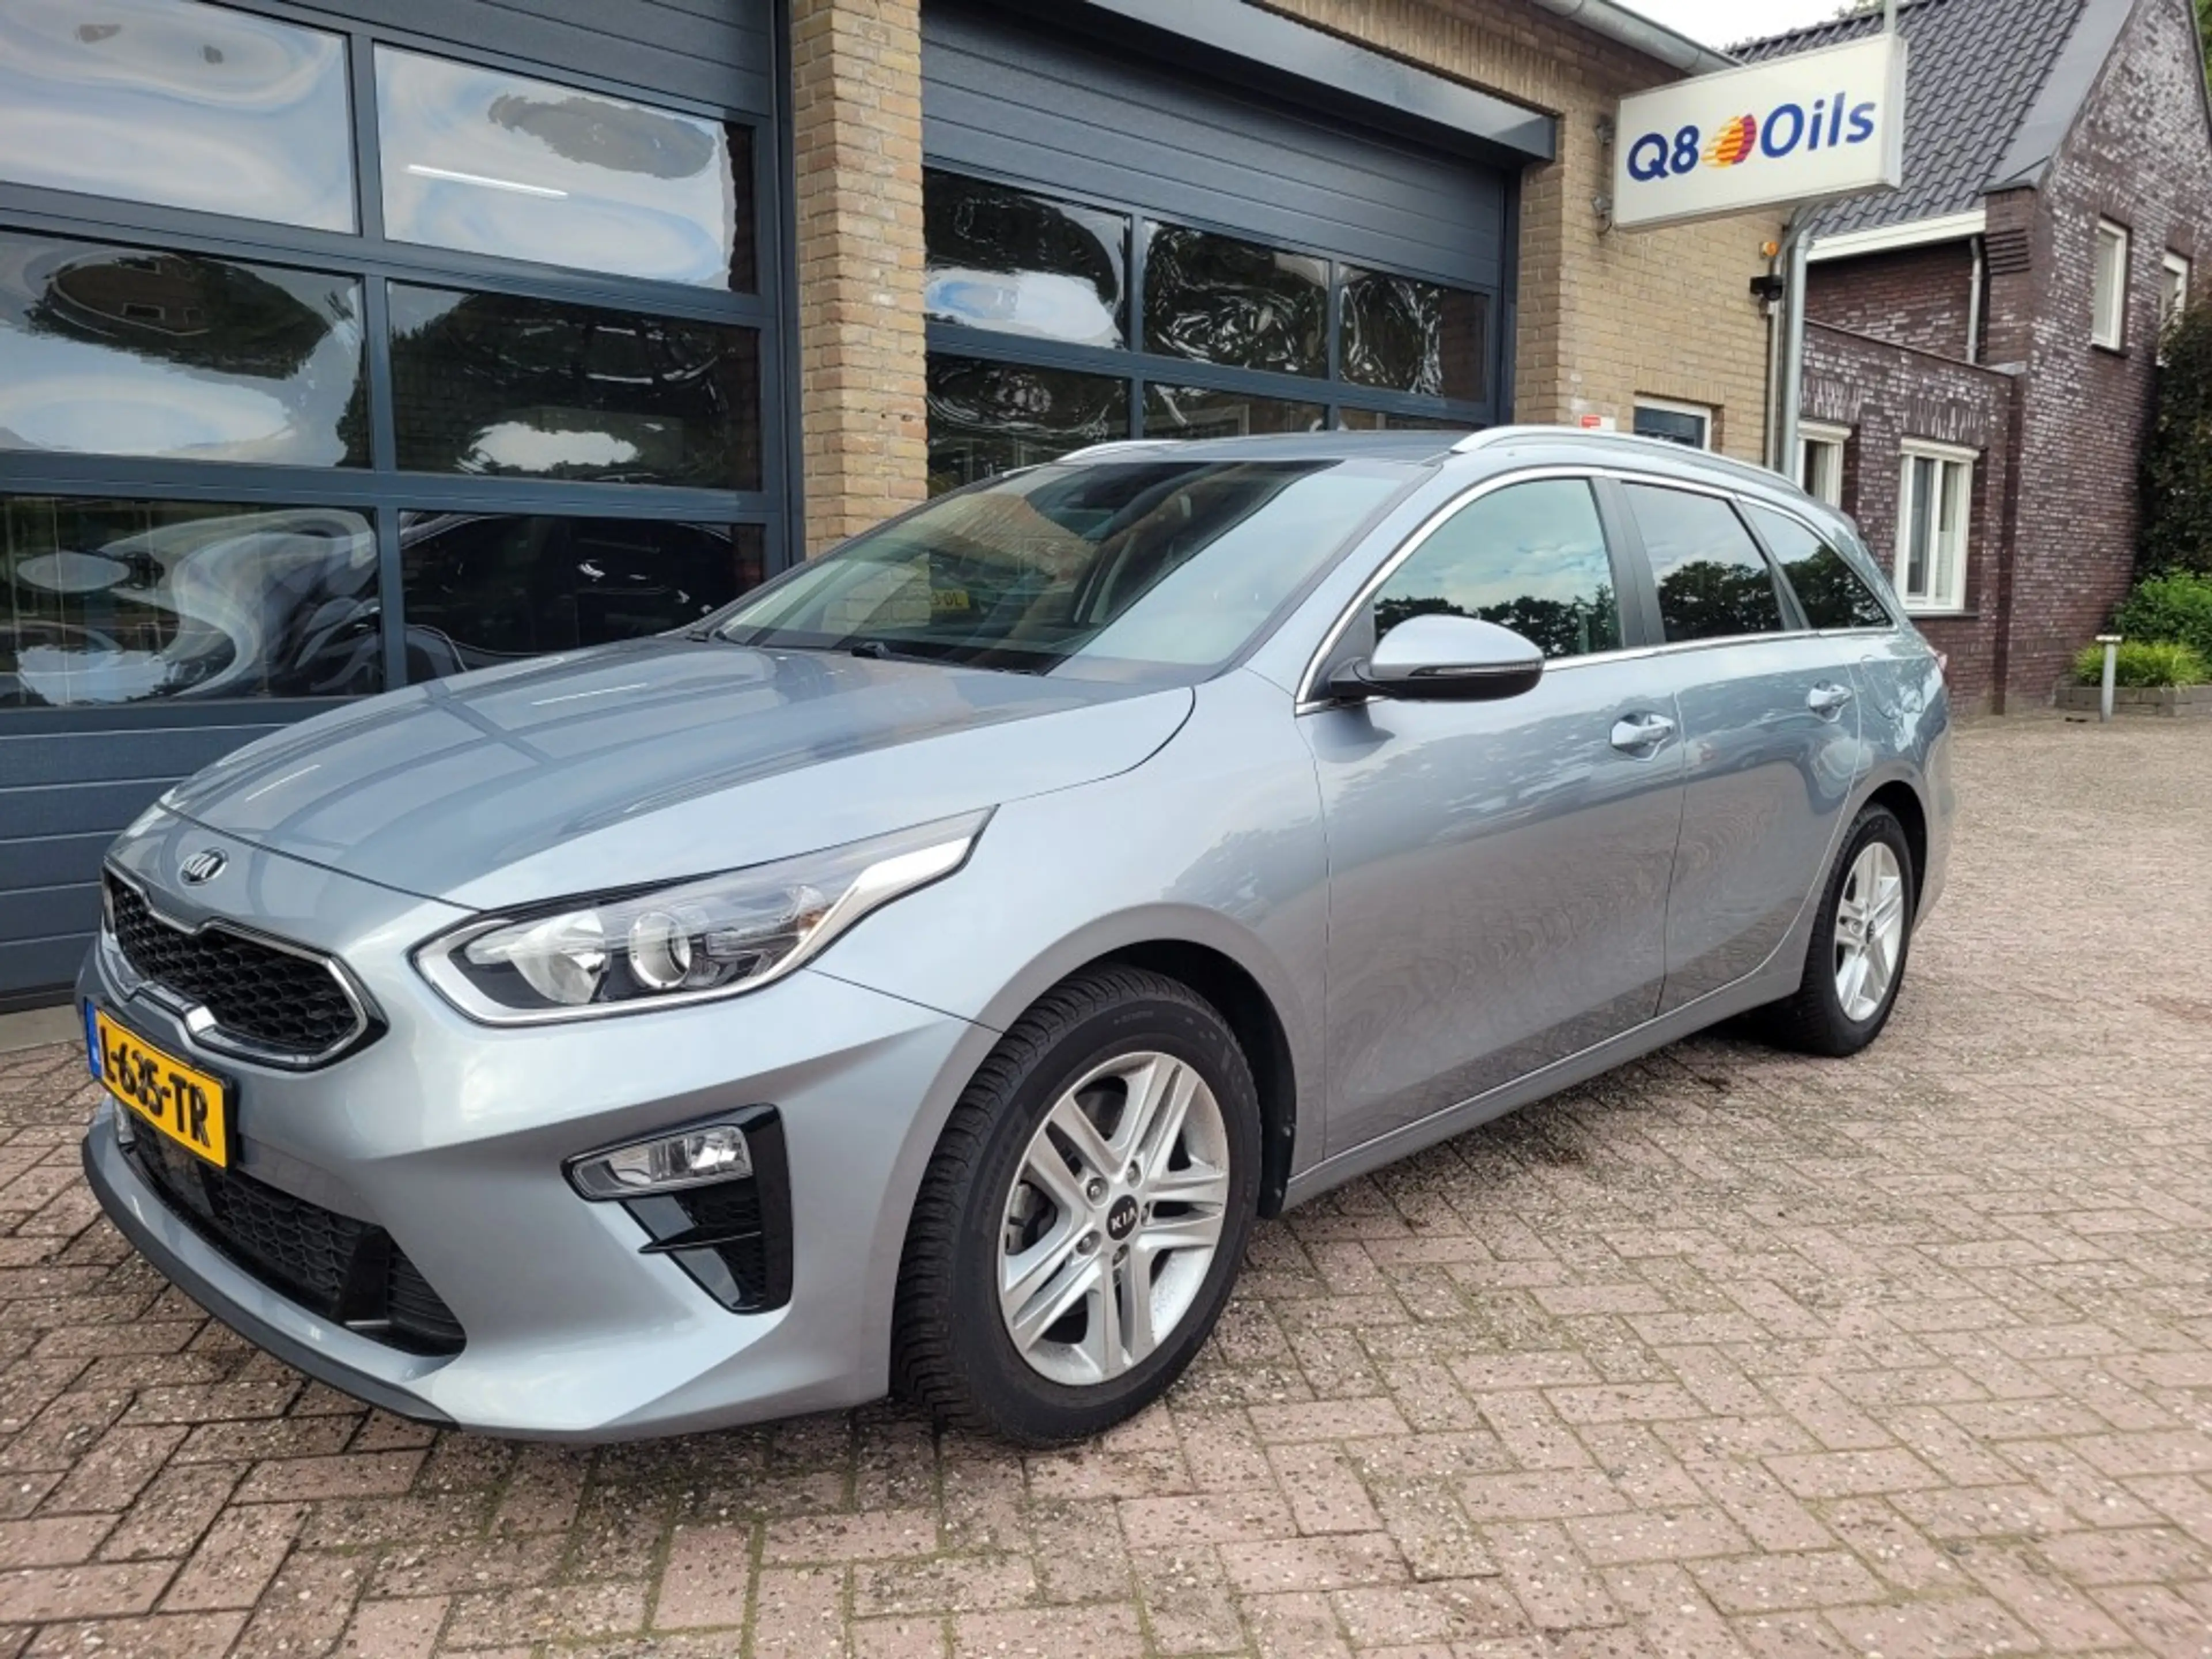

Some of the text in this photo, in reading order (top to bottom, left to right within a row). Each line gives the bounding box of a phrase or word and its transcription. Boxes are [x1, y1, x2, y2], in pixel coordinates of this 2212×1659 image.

[1627, 91, 1876, 182] Q8 Oils
[100, 1025, 211, 1149] L-635-TR
[1111, 1207, 1138, 1232] KIA
